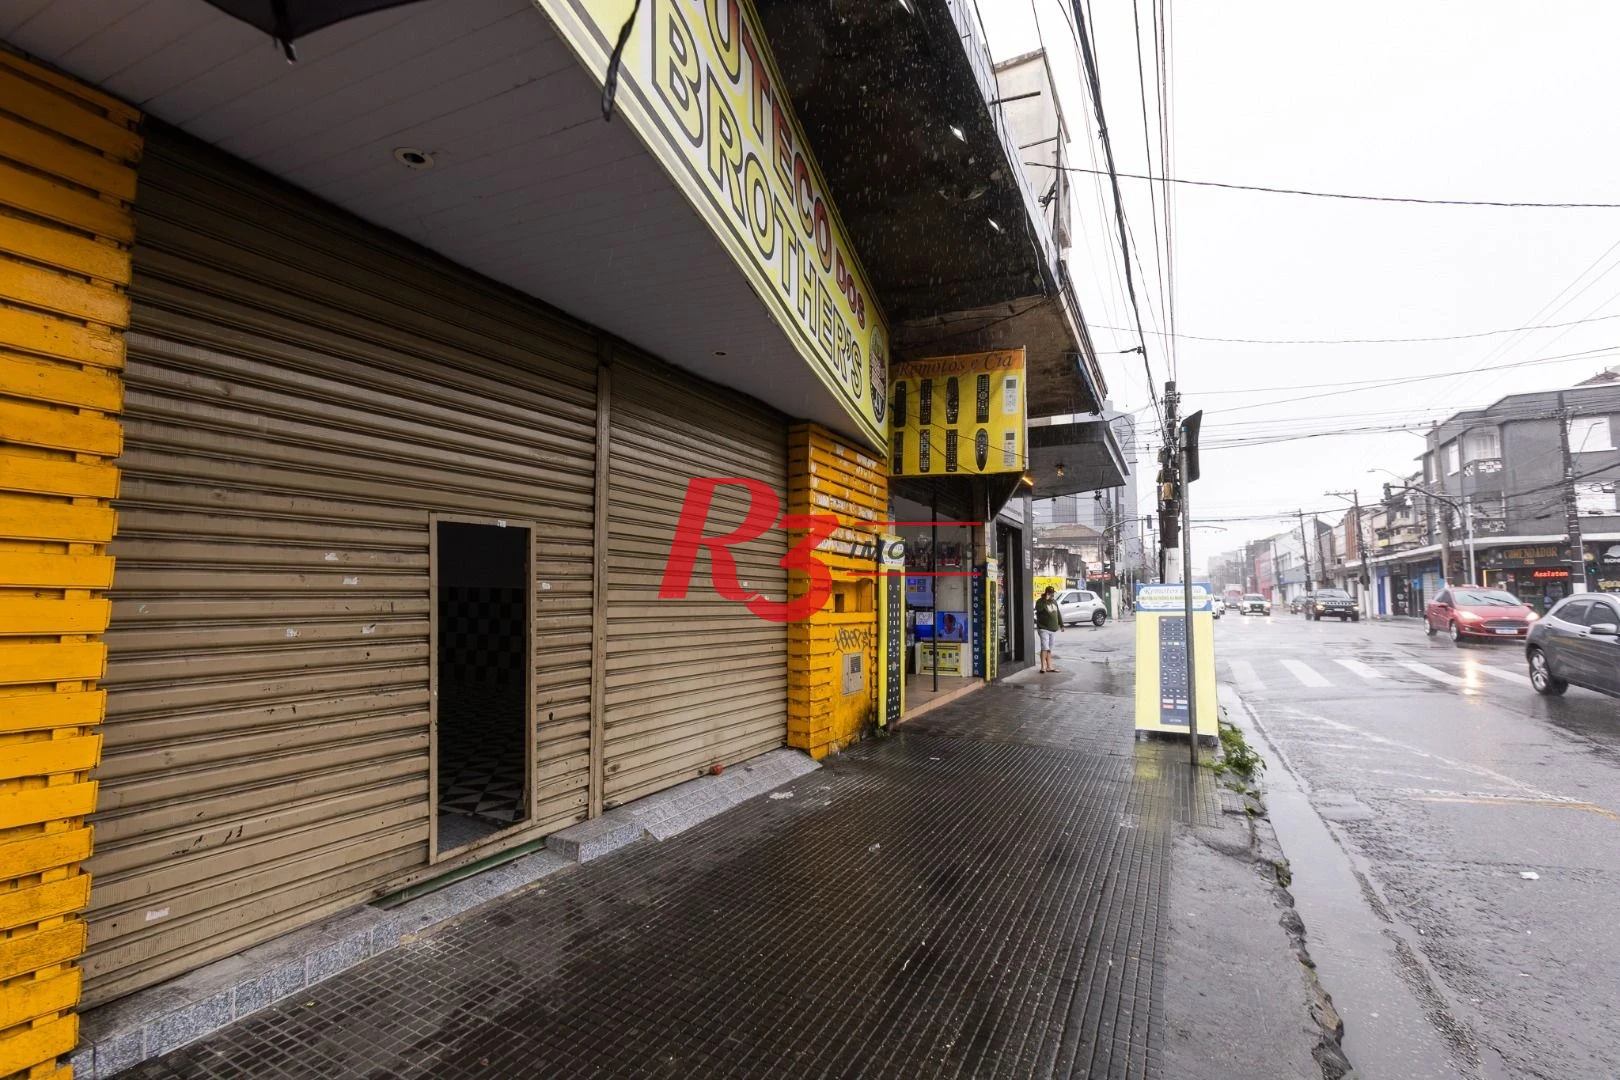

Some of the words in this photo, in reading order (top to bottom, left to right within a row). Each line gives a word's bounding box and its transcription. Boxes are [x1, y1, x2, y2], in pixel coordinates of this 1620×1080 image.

[651, 0, 863, 400] BROTHER'S
[692, 0, 832, 274] UTECO
[835, 257, 866, 330] DOS
[984, 351, 1013, 371] Cia
